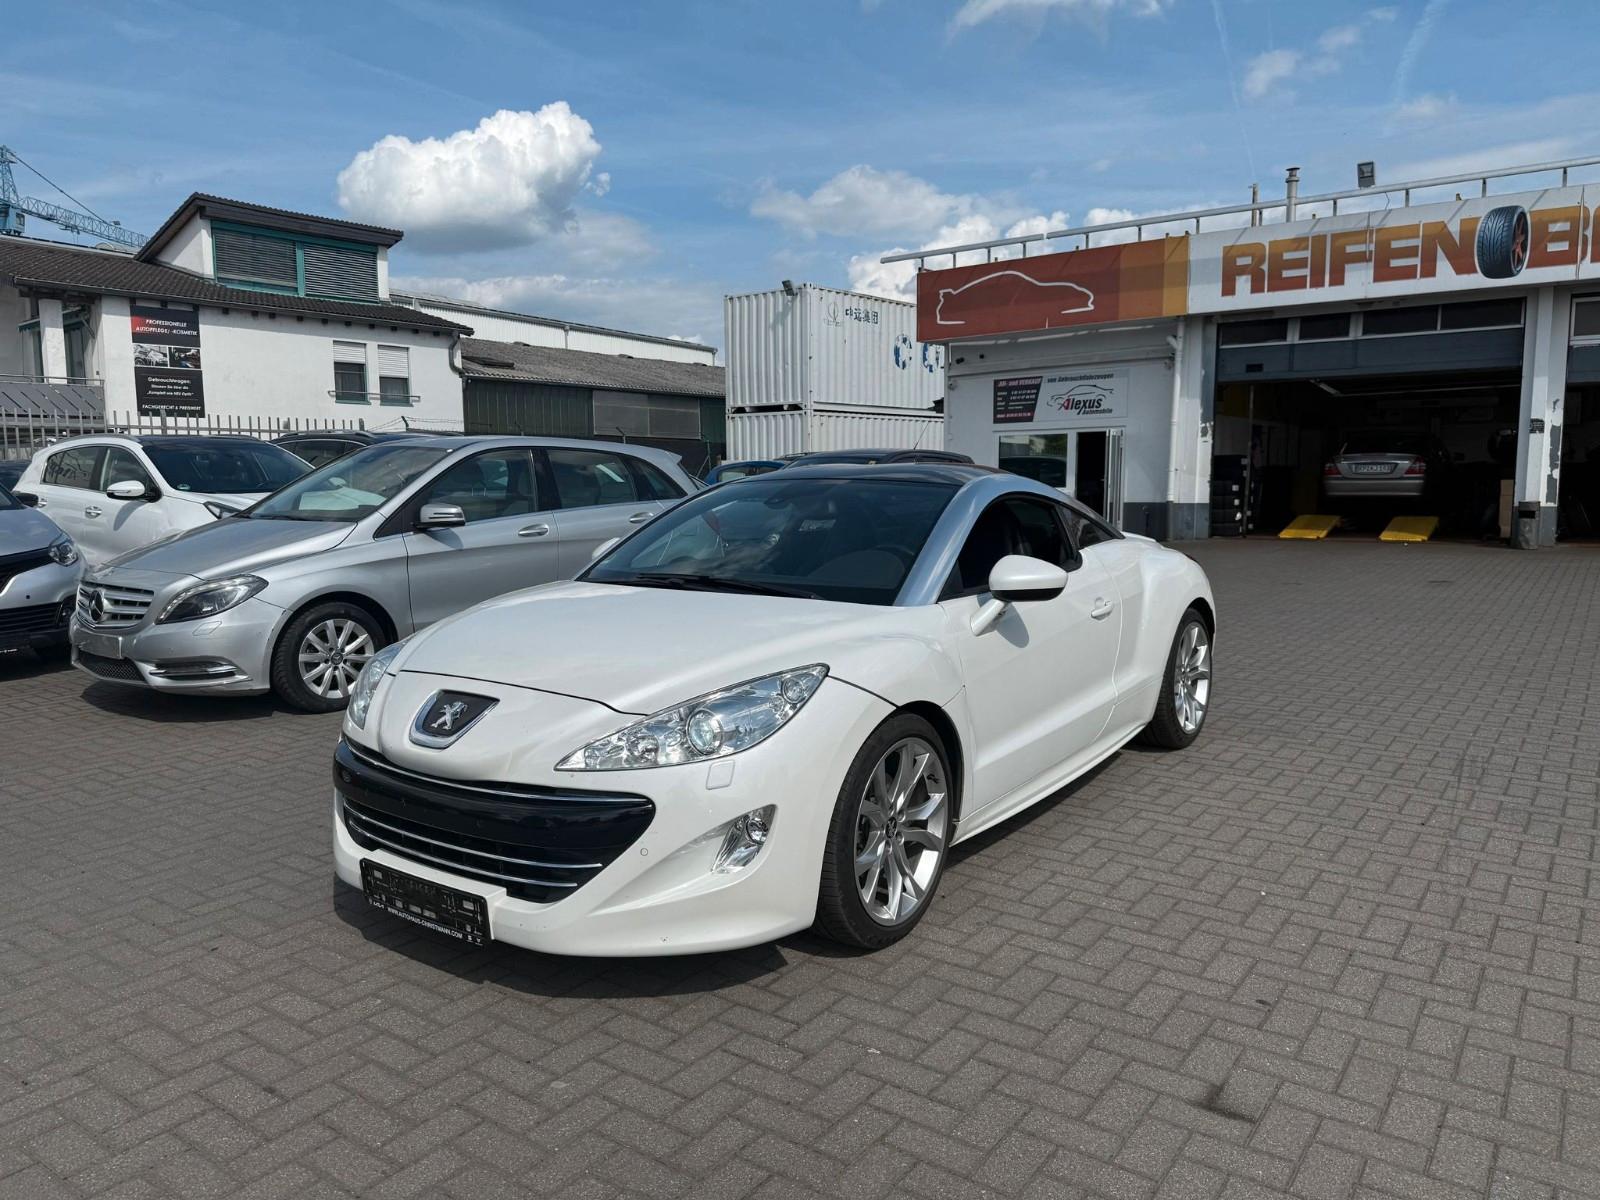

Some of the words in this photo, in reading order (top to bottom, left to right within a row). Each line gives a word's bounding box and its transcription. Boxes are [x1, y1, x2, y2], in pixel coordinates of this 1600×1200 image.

[1221, 217, 1482, 297] REIFEN
[1526, 205, 1600, 270] B
[1058, 397, 1103, 415] Alexus
